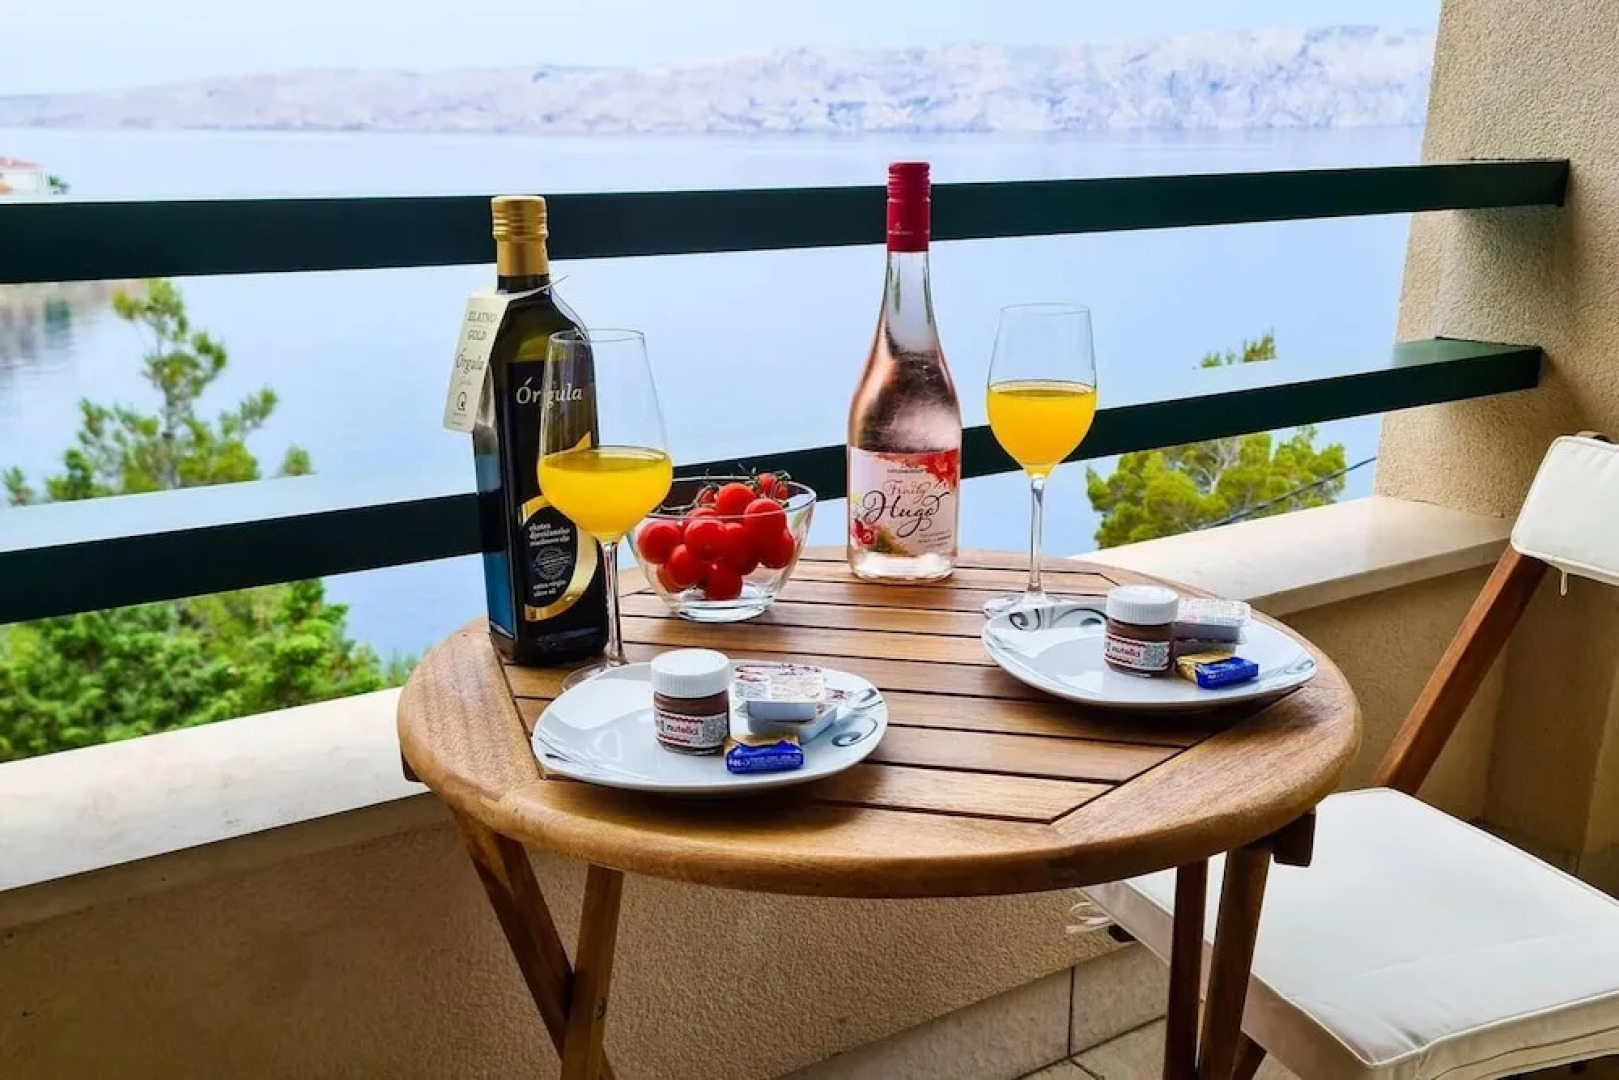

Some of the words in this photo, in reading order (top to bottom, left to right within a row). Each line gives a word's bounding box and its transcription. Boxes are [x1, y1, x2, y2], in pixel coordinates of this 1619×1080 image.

[468, 329, 487, 341] GOLD
[515, 376, 584, 409] Órgula
[863, 490, 950, 538] Hugo
[666, 723, 699, 734] nutella
